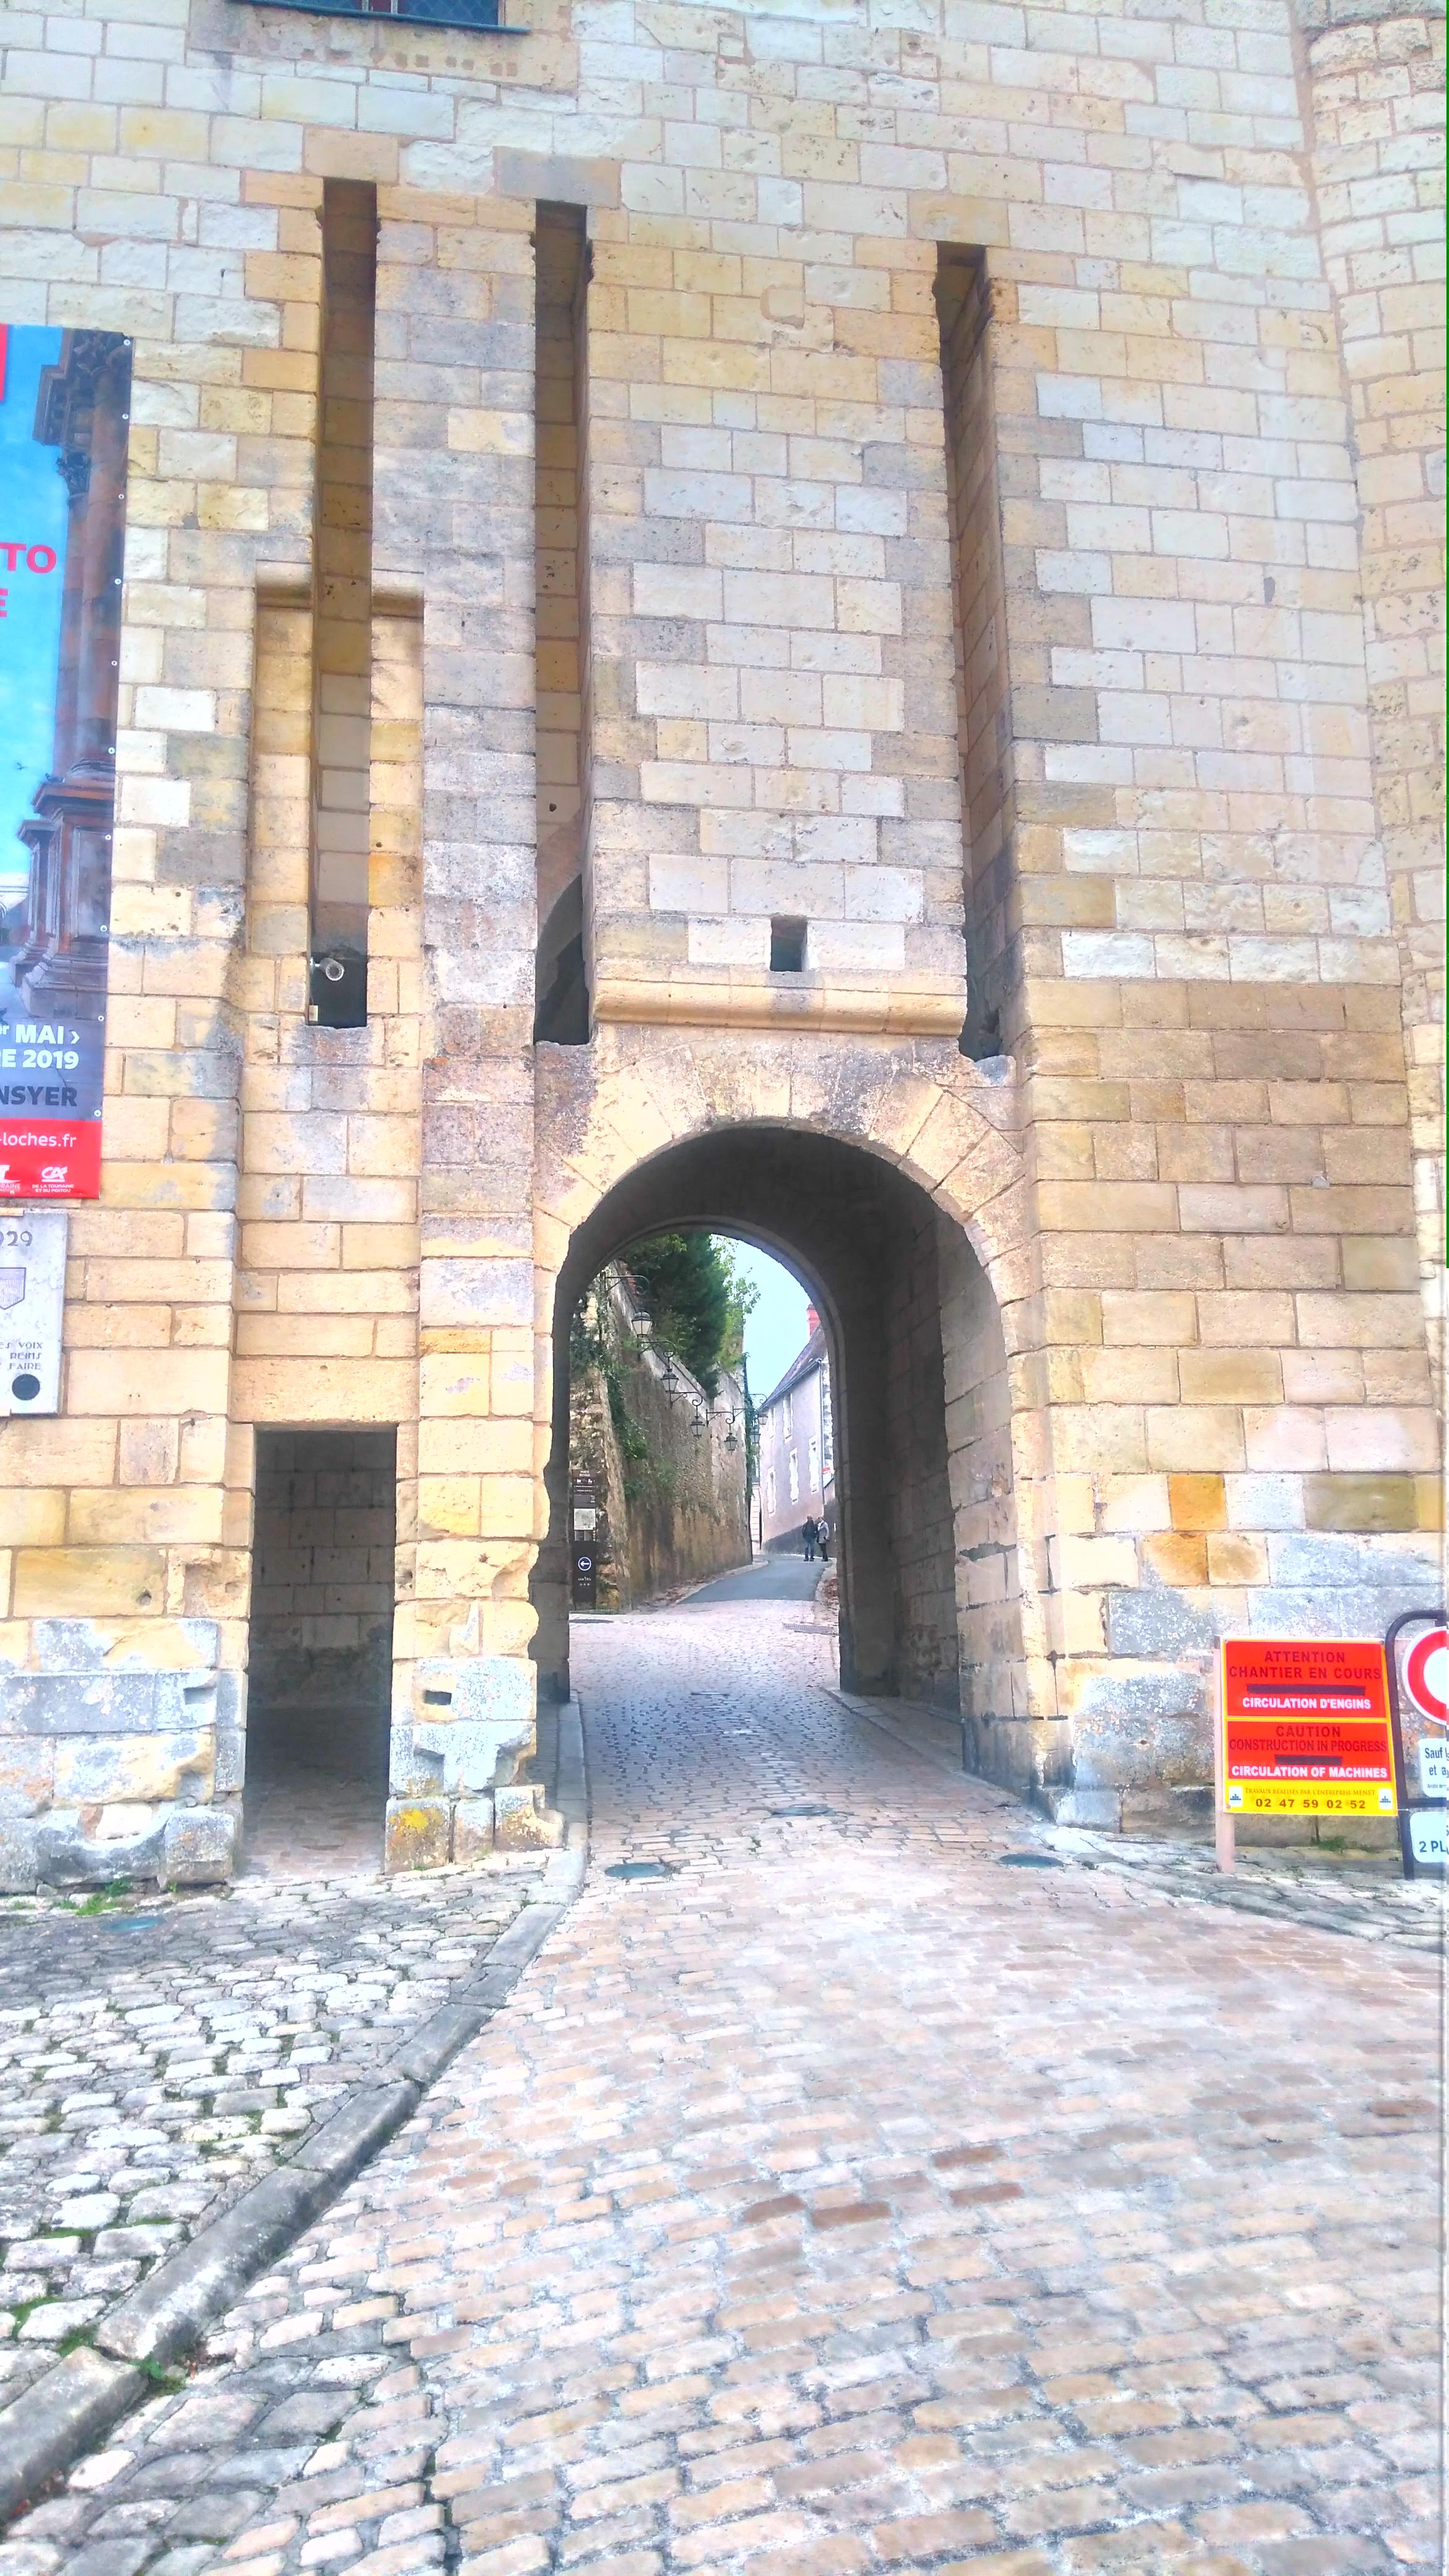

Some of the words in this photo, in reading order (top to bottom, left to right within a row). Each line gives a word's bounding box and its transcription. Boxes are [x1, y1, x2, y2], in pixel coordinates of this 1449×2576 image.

[15, 1024, 64, 1044] MAI
[22, 1050, 79, 1069] 2019
[1264, 1651, 1344, 1663] ATTENTION
[1229, 1666, 1302, 1678] CHANTIER
[1310, 1667, 1326, 1679] EN
[1334, 1668, 1382, 1679] COURS
[1242, 1697, 1316, 1708] CIRCULATION
[1320, 1699, 1371, 1709] D'ENGINS
[1276, 1725, 1341, 1737] CAUTION
[1229, 1739, 1314, 1751] CONSTRUCTION
[1317, 1740, 1328, 1751] IN
[1331, 1740, 1387, 1752] PROGRESS
[1424, 1747, 1443, 1759] Sauf
[1232, 1765, 1308, 1777] CIRCULATION
[1311, 1767, 1325, 1778] OF
[1329, 1767, 1387, 1778] MACHINES
[1429, 1764, 1437, 1776] et
[1256, 1798, 1271, 1808] 02
[1279, 1799, 1294, 1808] 47
[1303, 1799, 1318, 1808] 59
[1326, 1799, 1342, 1809] 02
[1350, 1799, 1366, 1809] 52
[1419, 1840, 1427, 1853] 2
